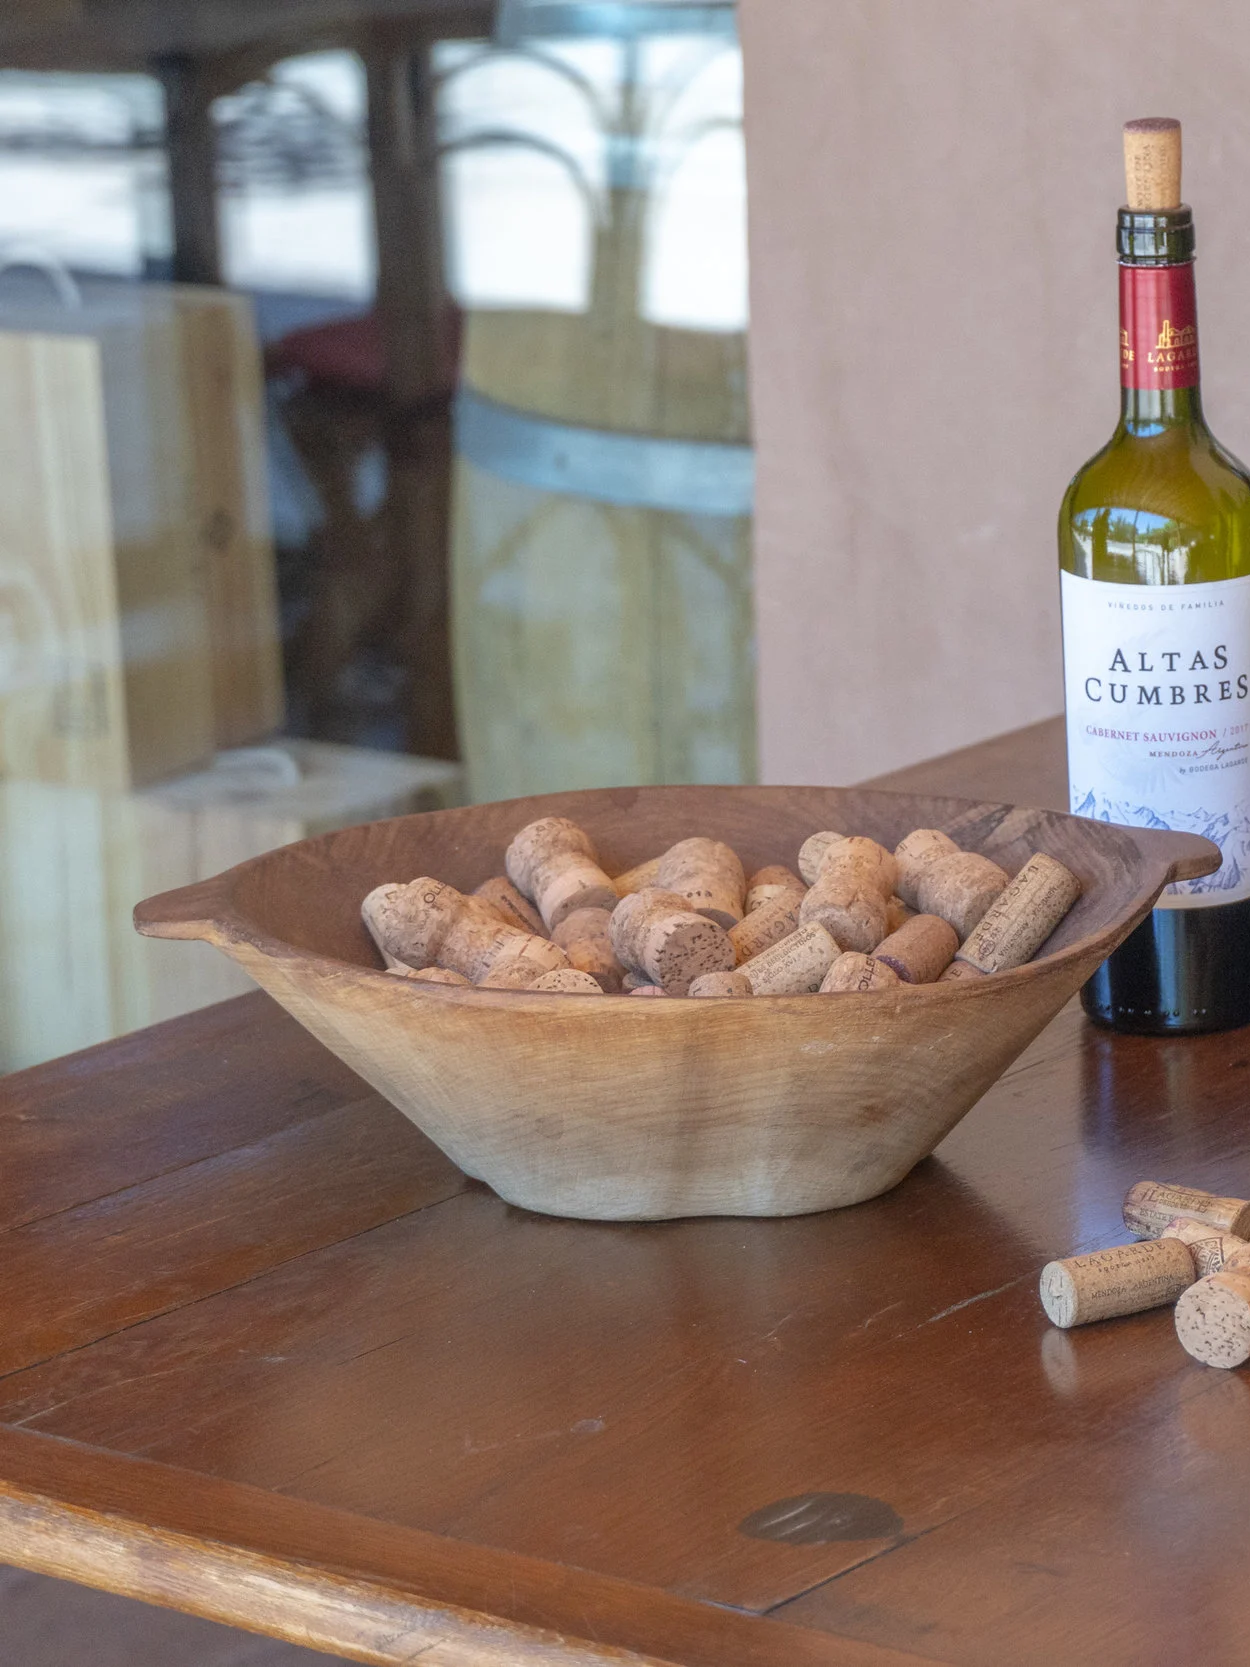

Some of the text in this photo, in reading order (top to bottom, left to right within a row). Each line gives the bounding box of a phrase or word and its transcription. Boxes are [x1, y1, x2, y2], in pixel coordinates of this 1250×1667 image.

[1160, 603, 1174, 611] DE
[1181, 599, 1225, 610] FAMILIA
[1109, 645, 1228, 673] ALTAS
[1085, 674, 1249, 706] CUMBRES
[1086, 725, 1140, 742] CABERNET
[1143, 729, 1217, 743] SAUVIGNON
[1230, 723, 1249, 736] 2017
[1149, 750, 1198, 758] MENDOZA
[1189, 763, 1220, 773] BODEGA
[1221, 757, 1249, 769] LAGARDE
[973, 864, 1038, 943] LAGARDE
[1073, 1236, 1166, 1272] LAGARDE
